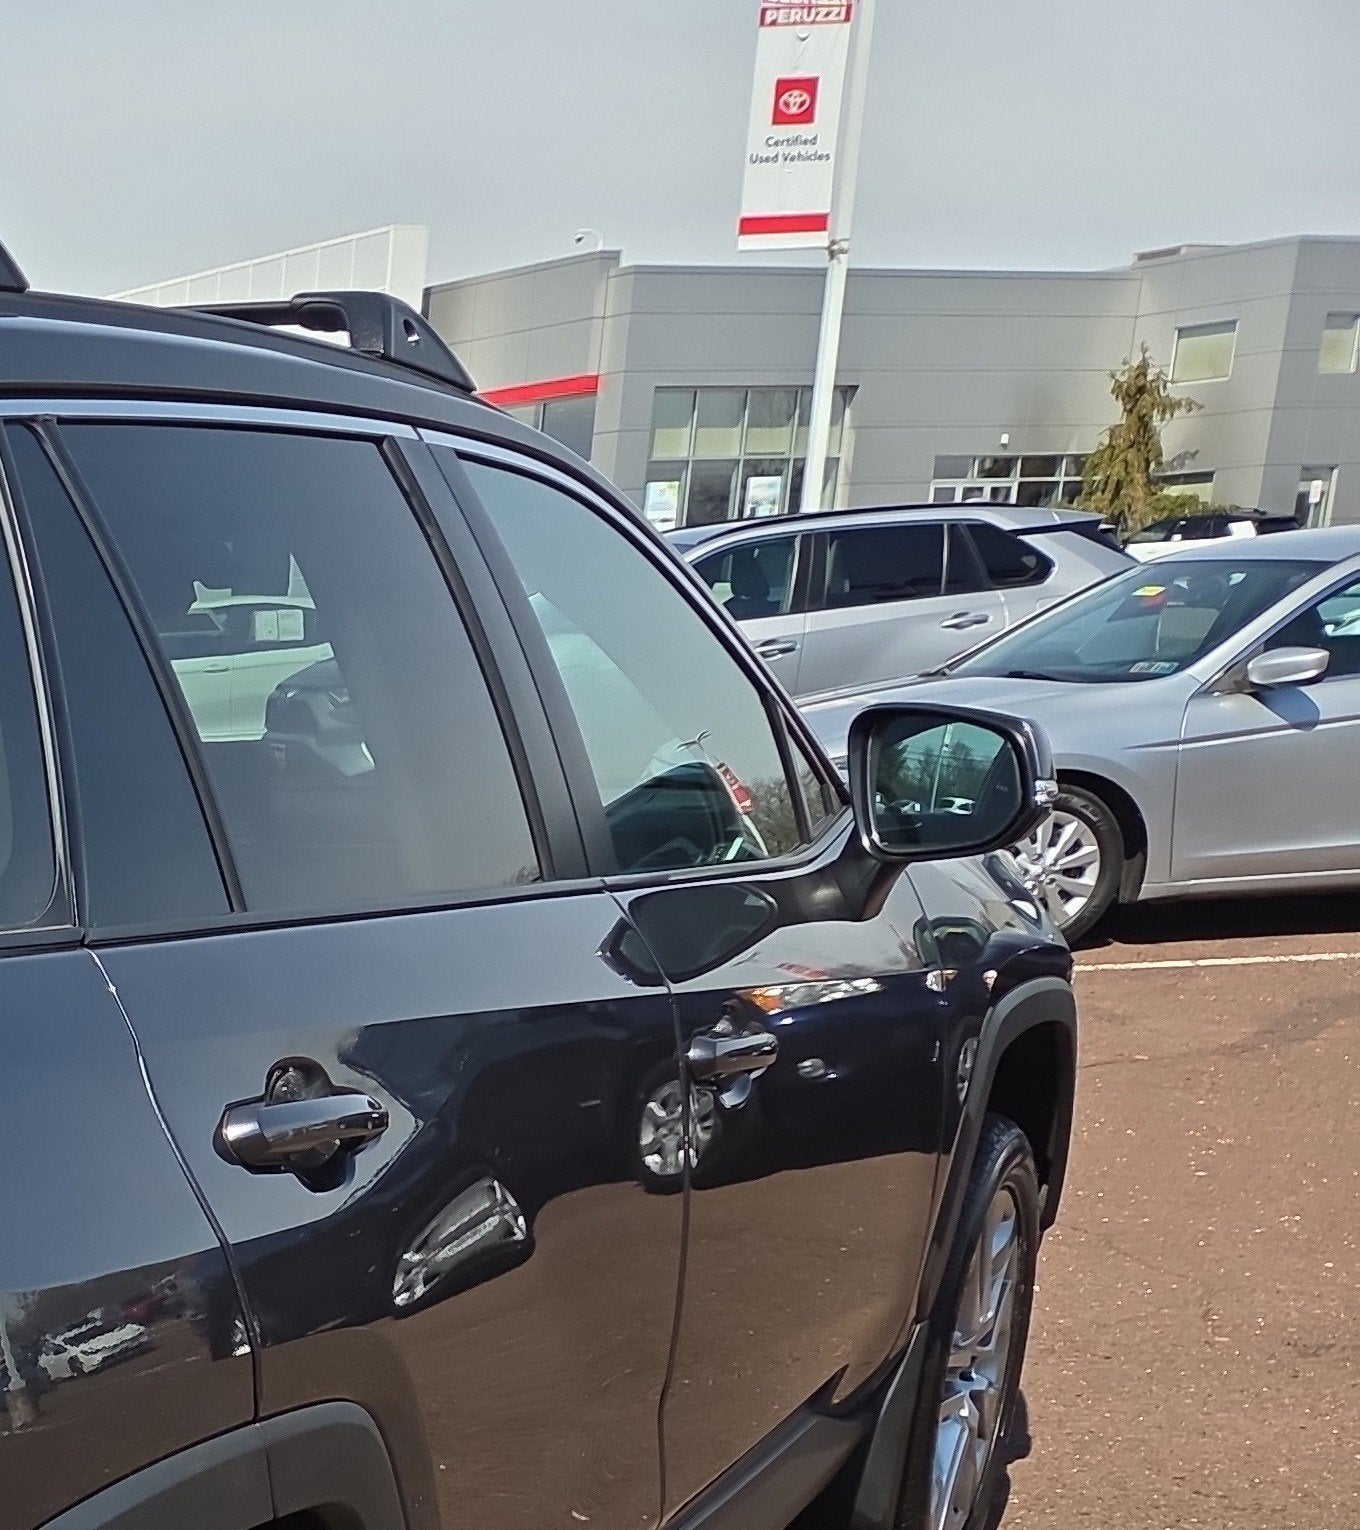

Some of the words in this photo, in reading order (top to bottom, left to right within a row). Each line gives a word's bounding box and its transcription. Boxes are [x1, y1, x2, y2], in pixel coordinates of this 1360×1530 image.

[764, 6, 846, 24] PERUZZI
[765, 134, 818, 148] Certified
[749, 153, 779, 165] Used
[782, 150, 830, 163] Vehicles
